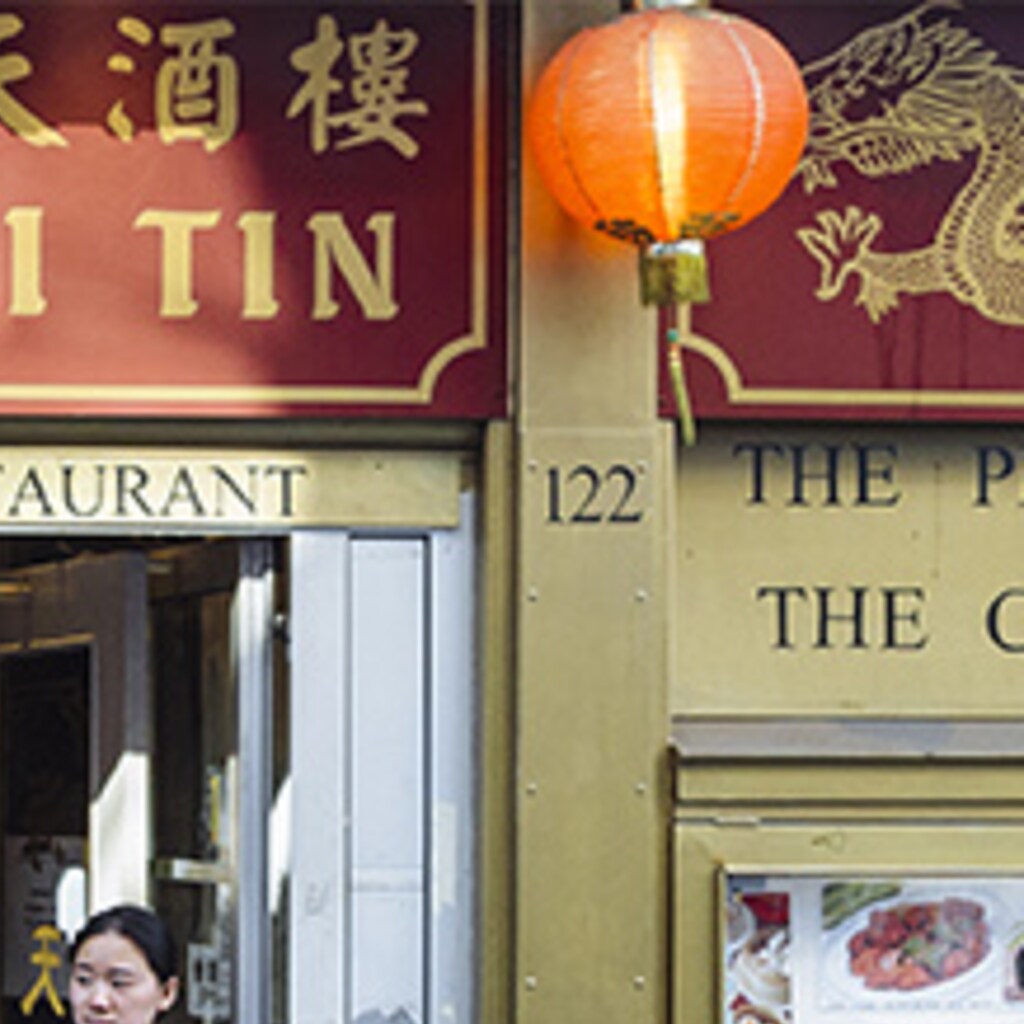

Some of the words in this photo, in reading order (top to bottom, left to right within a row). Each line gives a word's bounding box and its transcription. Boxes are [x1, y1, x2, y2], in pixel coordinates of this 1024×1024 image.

[133, 209, 400, 322] TIN
[545, 464, 644, 524] 122
[732, 442, 902, 508] THE
[756, 586, 930, 650] THE
